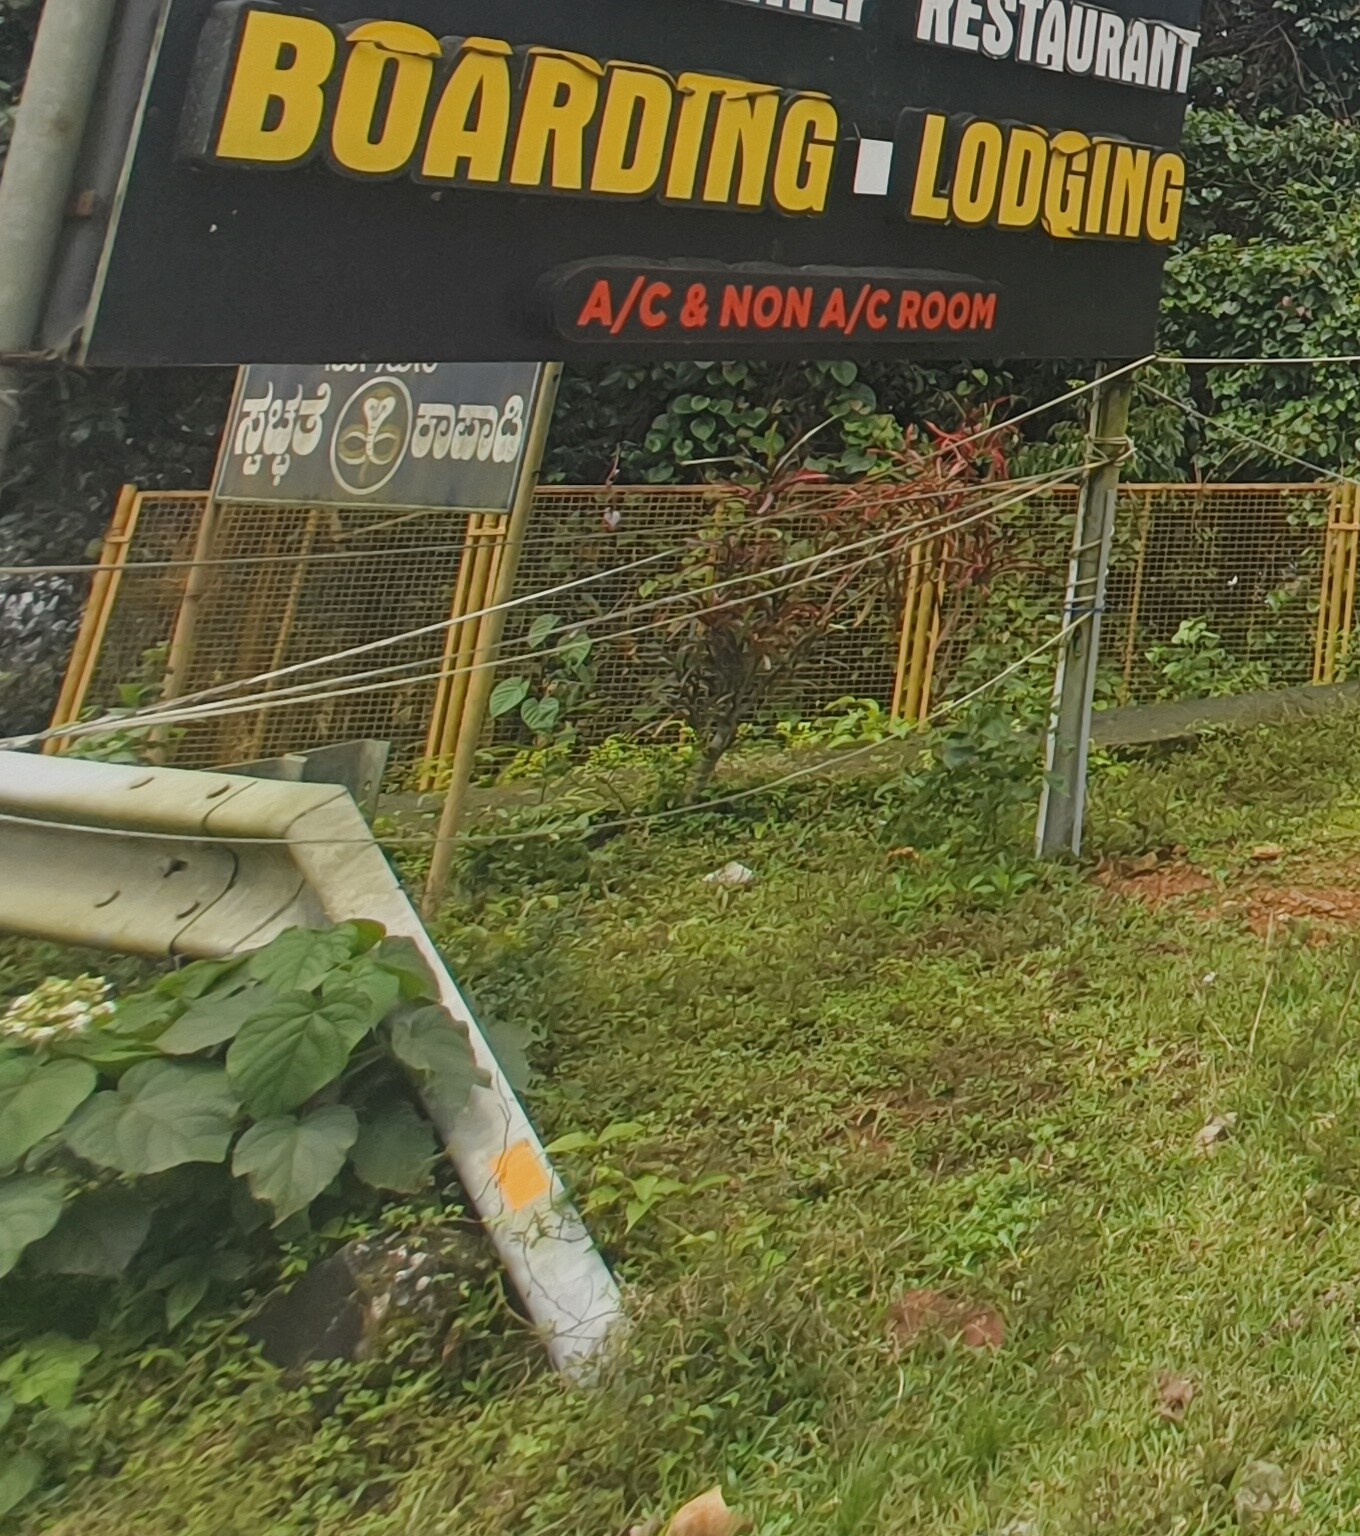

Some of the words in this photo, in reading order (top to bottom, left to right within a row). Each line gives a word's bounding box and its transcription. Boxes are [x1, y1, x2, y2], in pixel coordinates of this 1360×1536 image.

[215, 9, 839, 214] BOARDING
[911, 114, 1186, 241] LODGING
[577, 276, 671, 334] A/C
[680, 283, 709, 328] &
[719, 284, 813, 328] NON
[819, 284, 890, 335] A/C
[897, 290, 997, 330] ROOM
[234, 381, 332, 486] ಸ್ವಚ್ಛತೆ
[411, 394, 524, 463] ಕಾಪಾಡಿ
